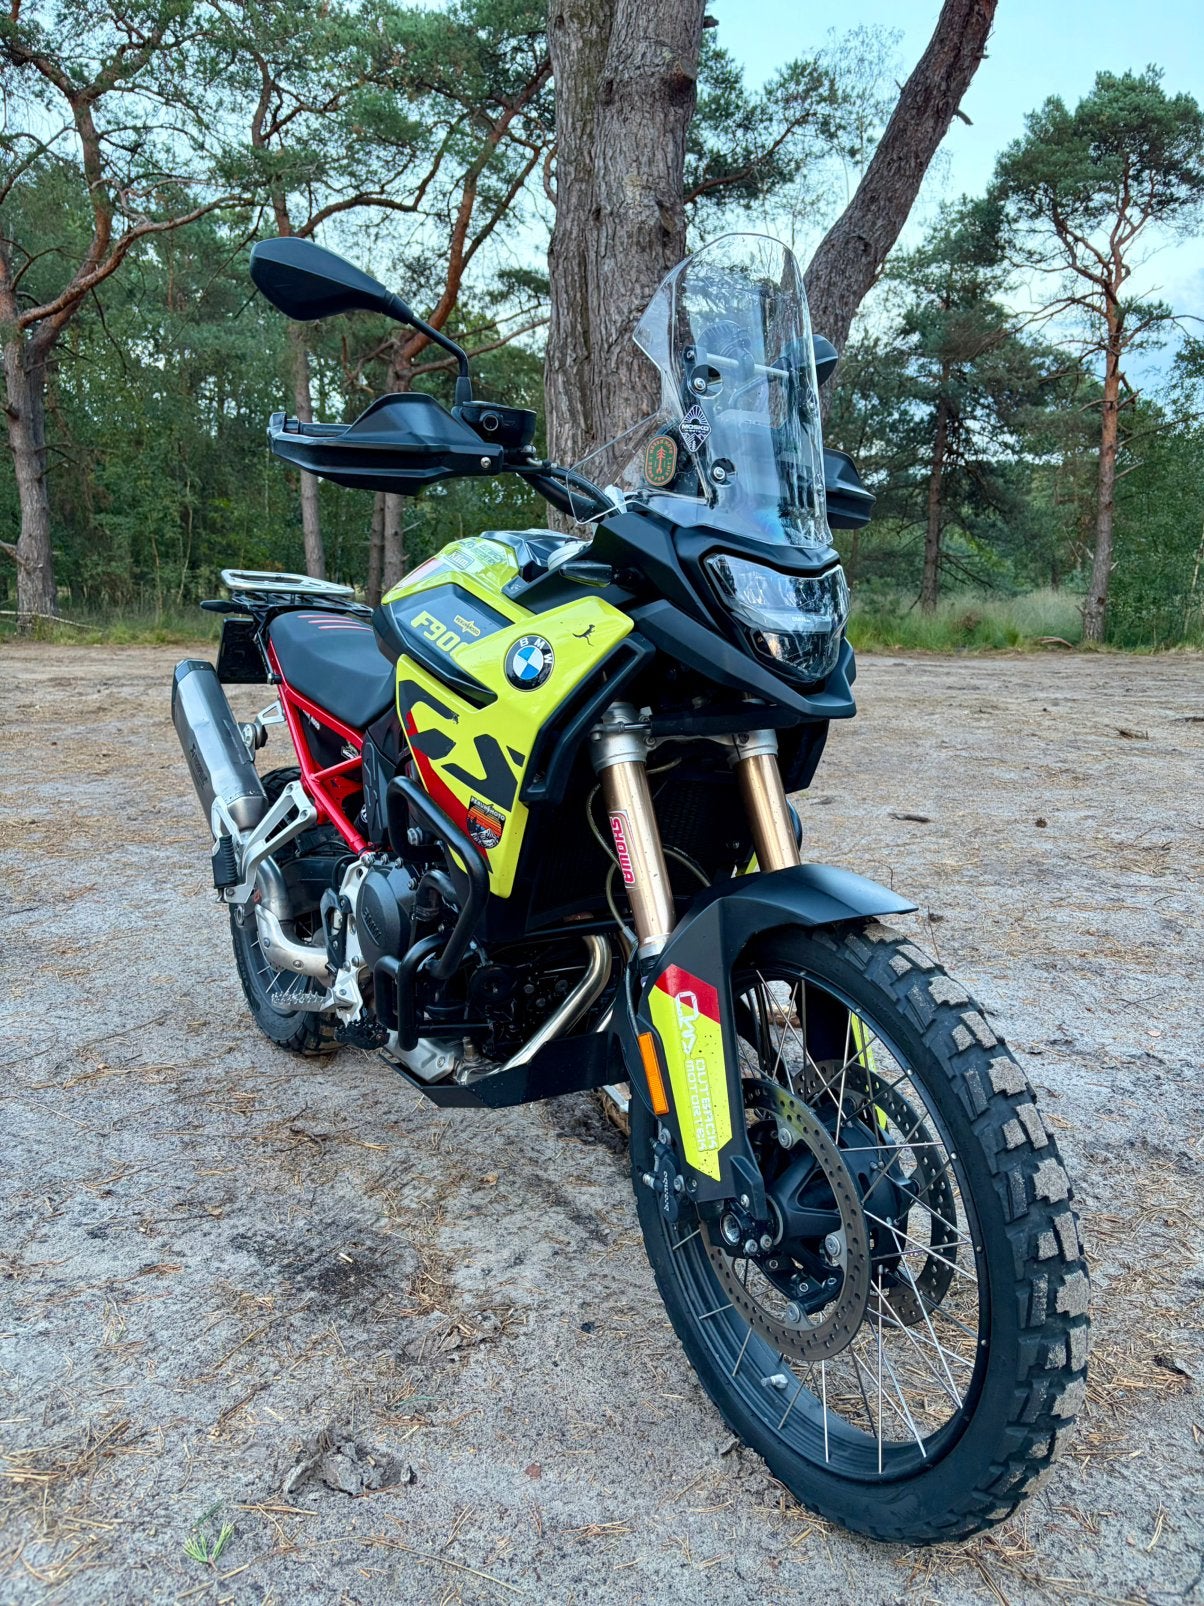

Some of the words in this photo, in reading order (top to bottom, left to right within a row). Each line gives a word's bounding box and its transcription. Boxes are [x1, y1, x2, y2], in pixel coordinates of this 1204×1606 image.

[519, 638, 553, 664] BMW
[610, 816, 635, 883] SHOWA
[685, 1060, 706, 1151] MOTORTEK
[695, 1059, 717, 1150] OUTBACK
